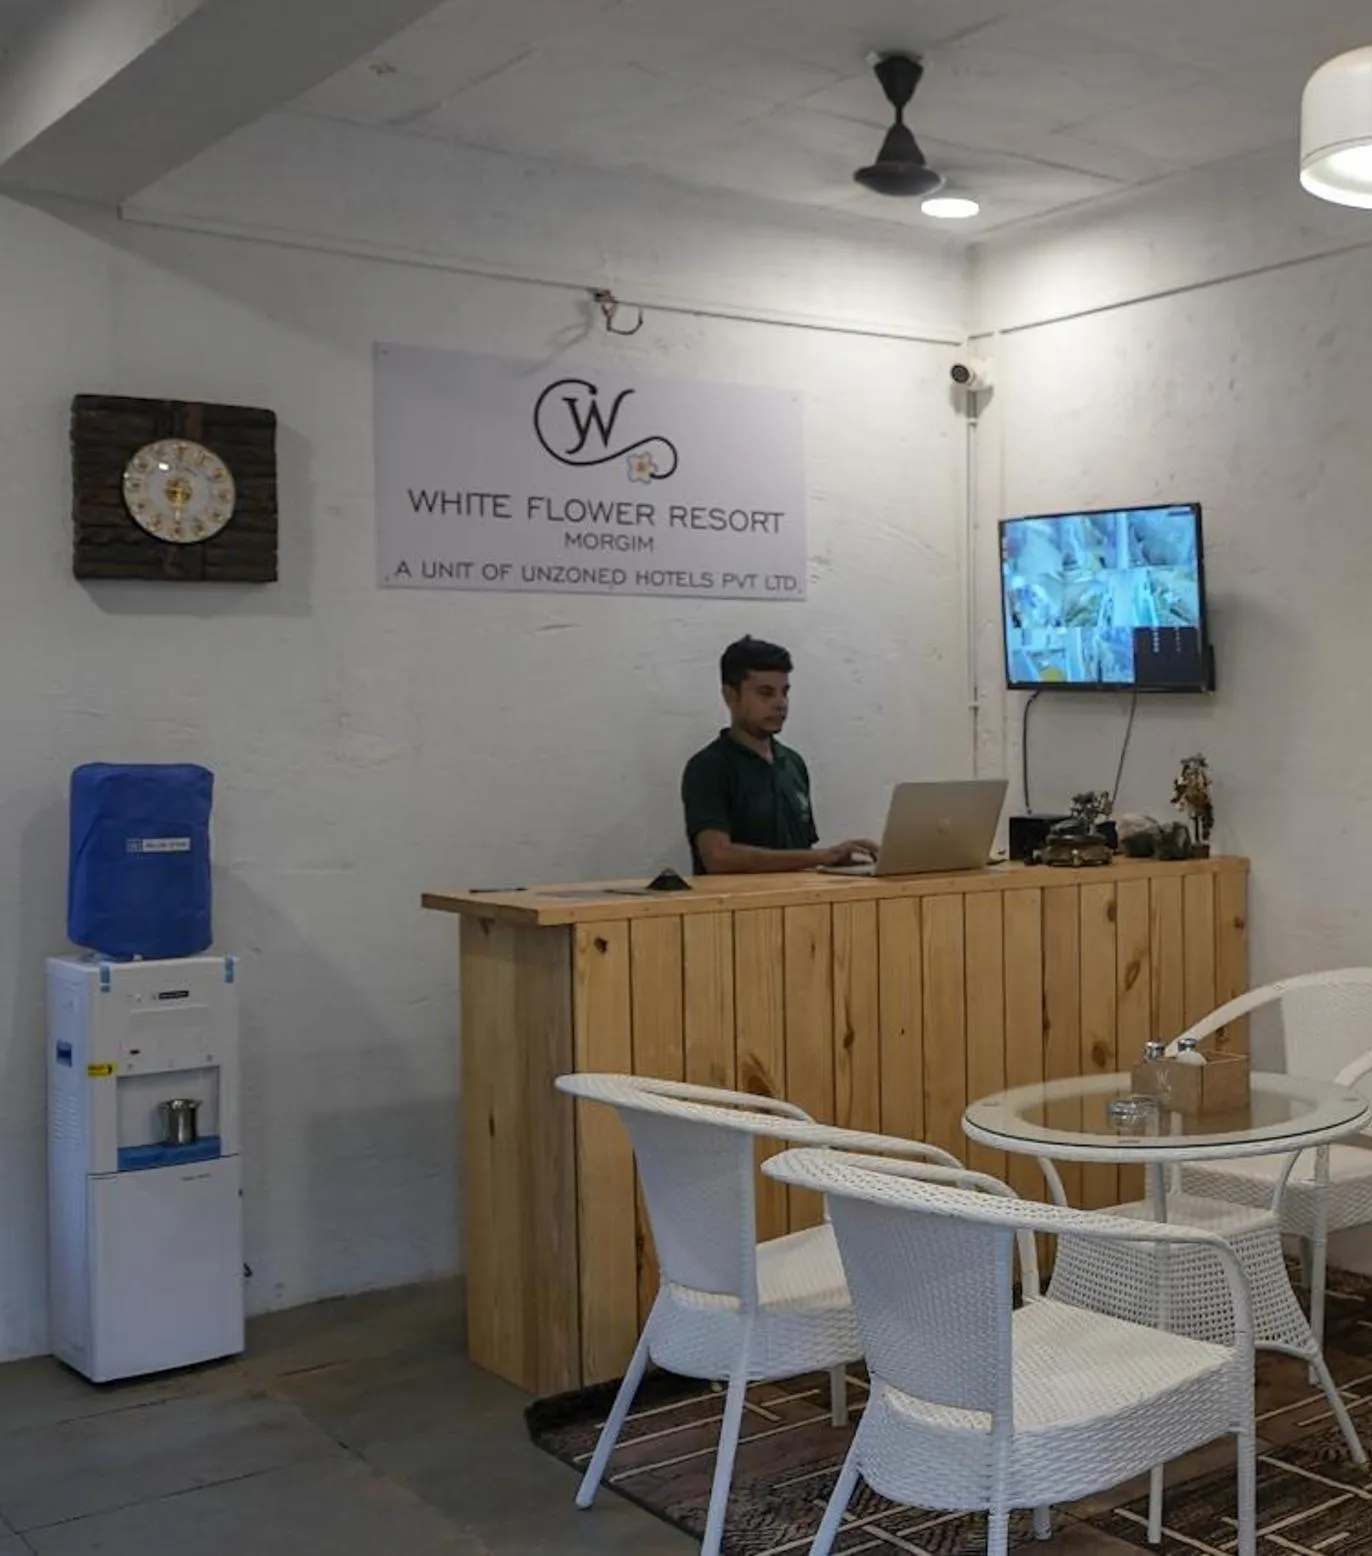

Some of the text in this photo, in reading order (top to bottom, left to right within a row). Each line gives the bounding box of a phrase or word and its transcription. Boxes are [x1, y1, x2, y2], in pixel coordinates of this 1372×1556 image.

[408, 488, 785, 533] WHITE FLOWER RESORT
[564, 532, 654, 552] MORGIM
[395, 560, 412, 578] A
[421, 560, 475, 580] UNIT
[482, 563, 513, 581] OF
[521, 565, 628, 586] UNZONED
[636, 570, 715, 589] HOTELS
[722, 573, 758, 589] PVT
